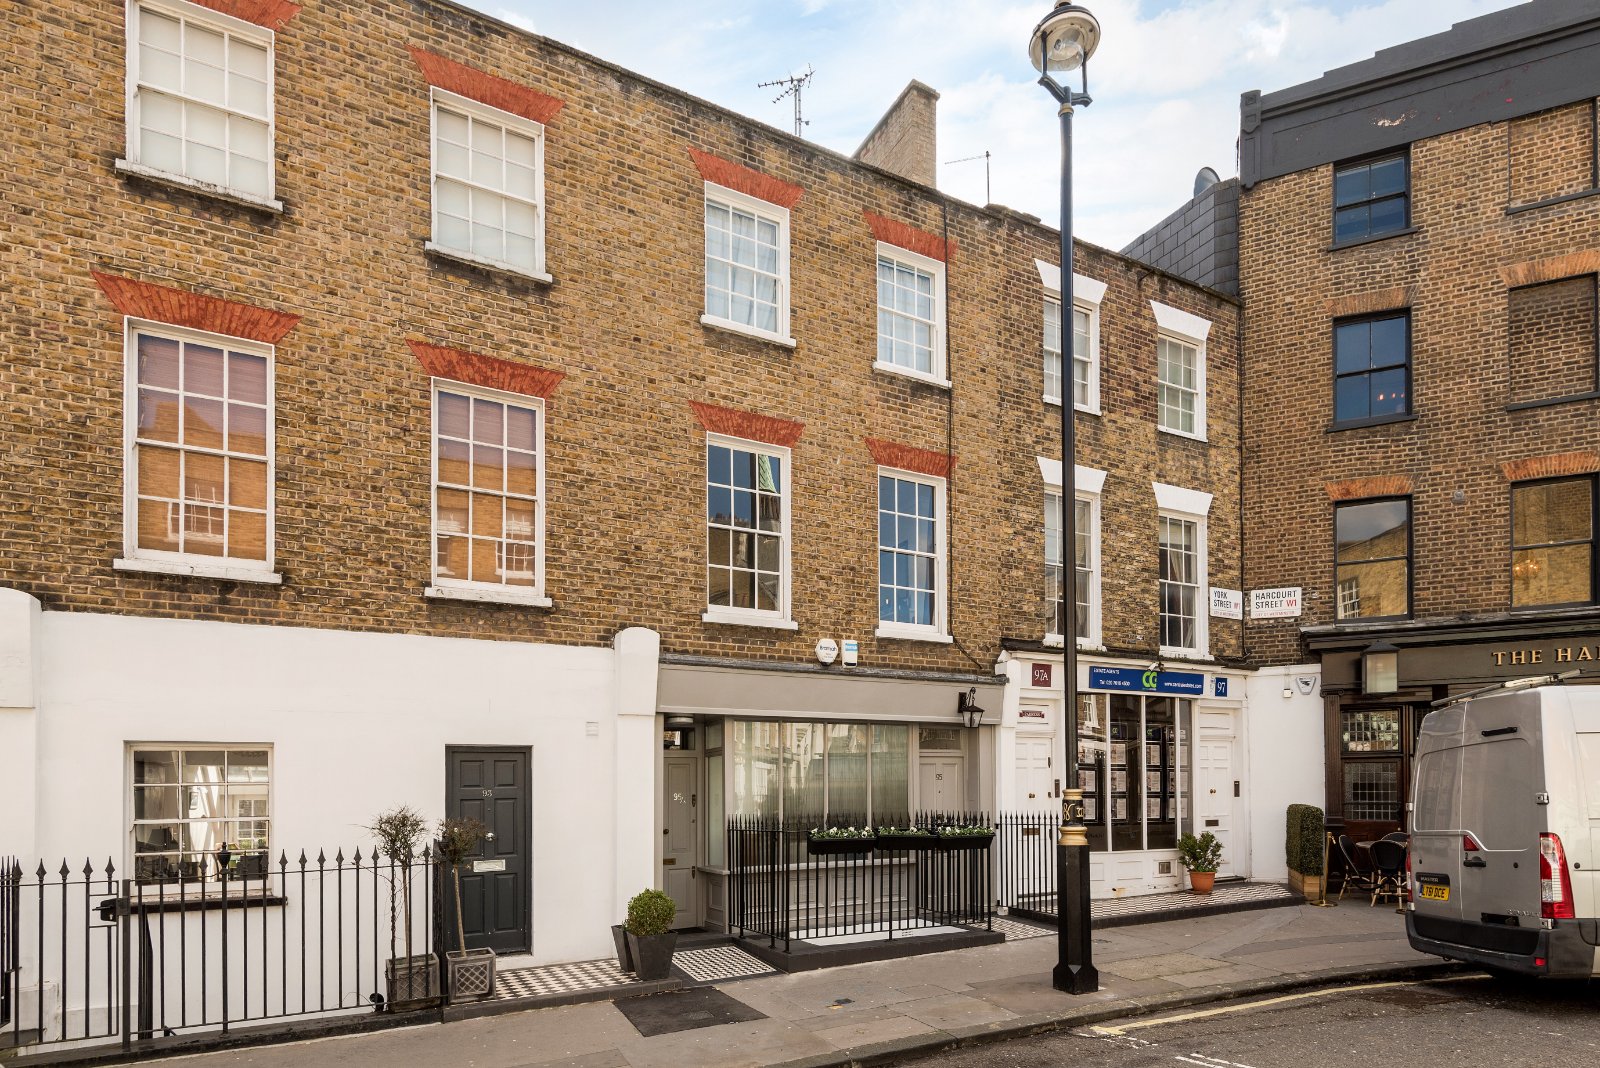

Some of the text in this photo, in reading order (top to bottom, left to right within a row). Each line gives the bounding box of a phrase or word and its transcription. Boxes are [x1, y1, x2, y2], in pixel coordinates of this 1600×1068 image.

[1213, 590, 1228, 599] YORK
[1255, 590, 1297, 600] HARCOURT
[1213, 599, 1232, 609] STREET
[1255, 599, 1297, 609] STREET W1
[1491, 649, 1543, 666] THE
[1034, 669, 1049, 681] 97A
[1217, 681, 1226, 693] 97
[935, 773, 943, 781] 95
[482, 789, 493, 797] 93
